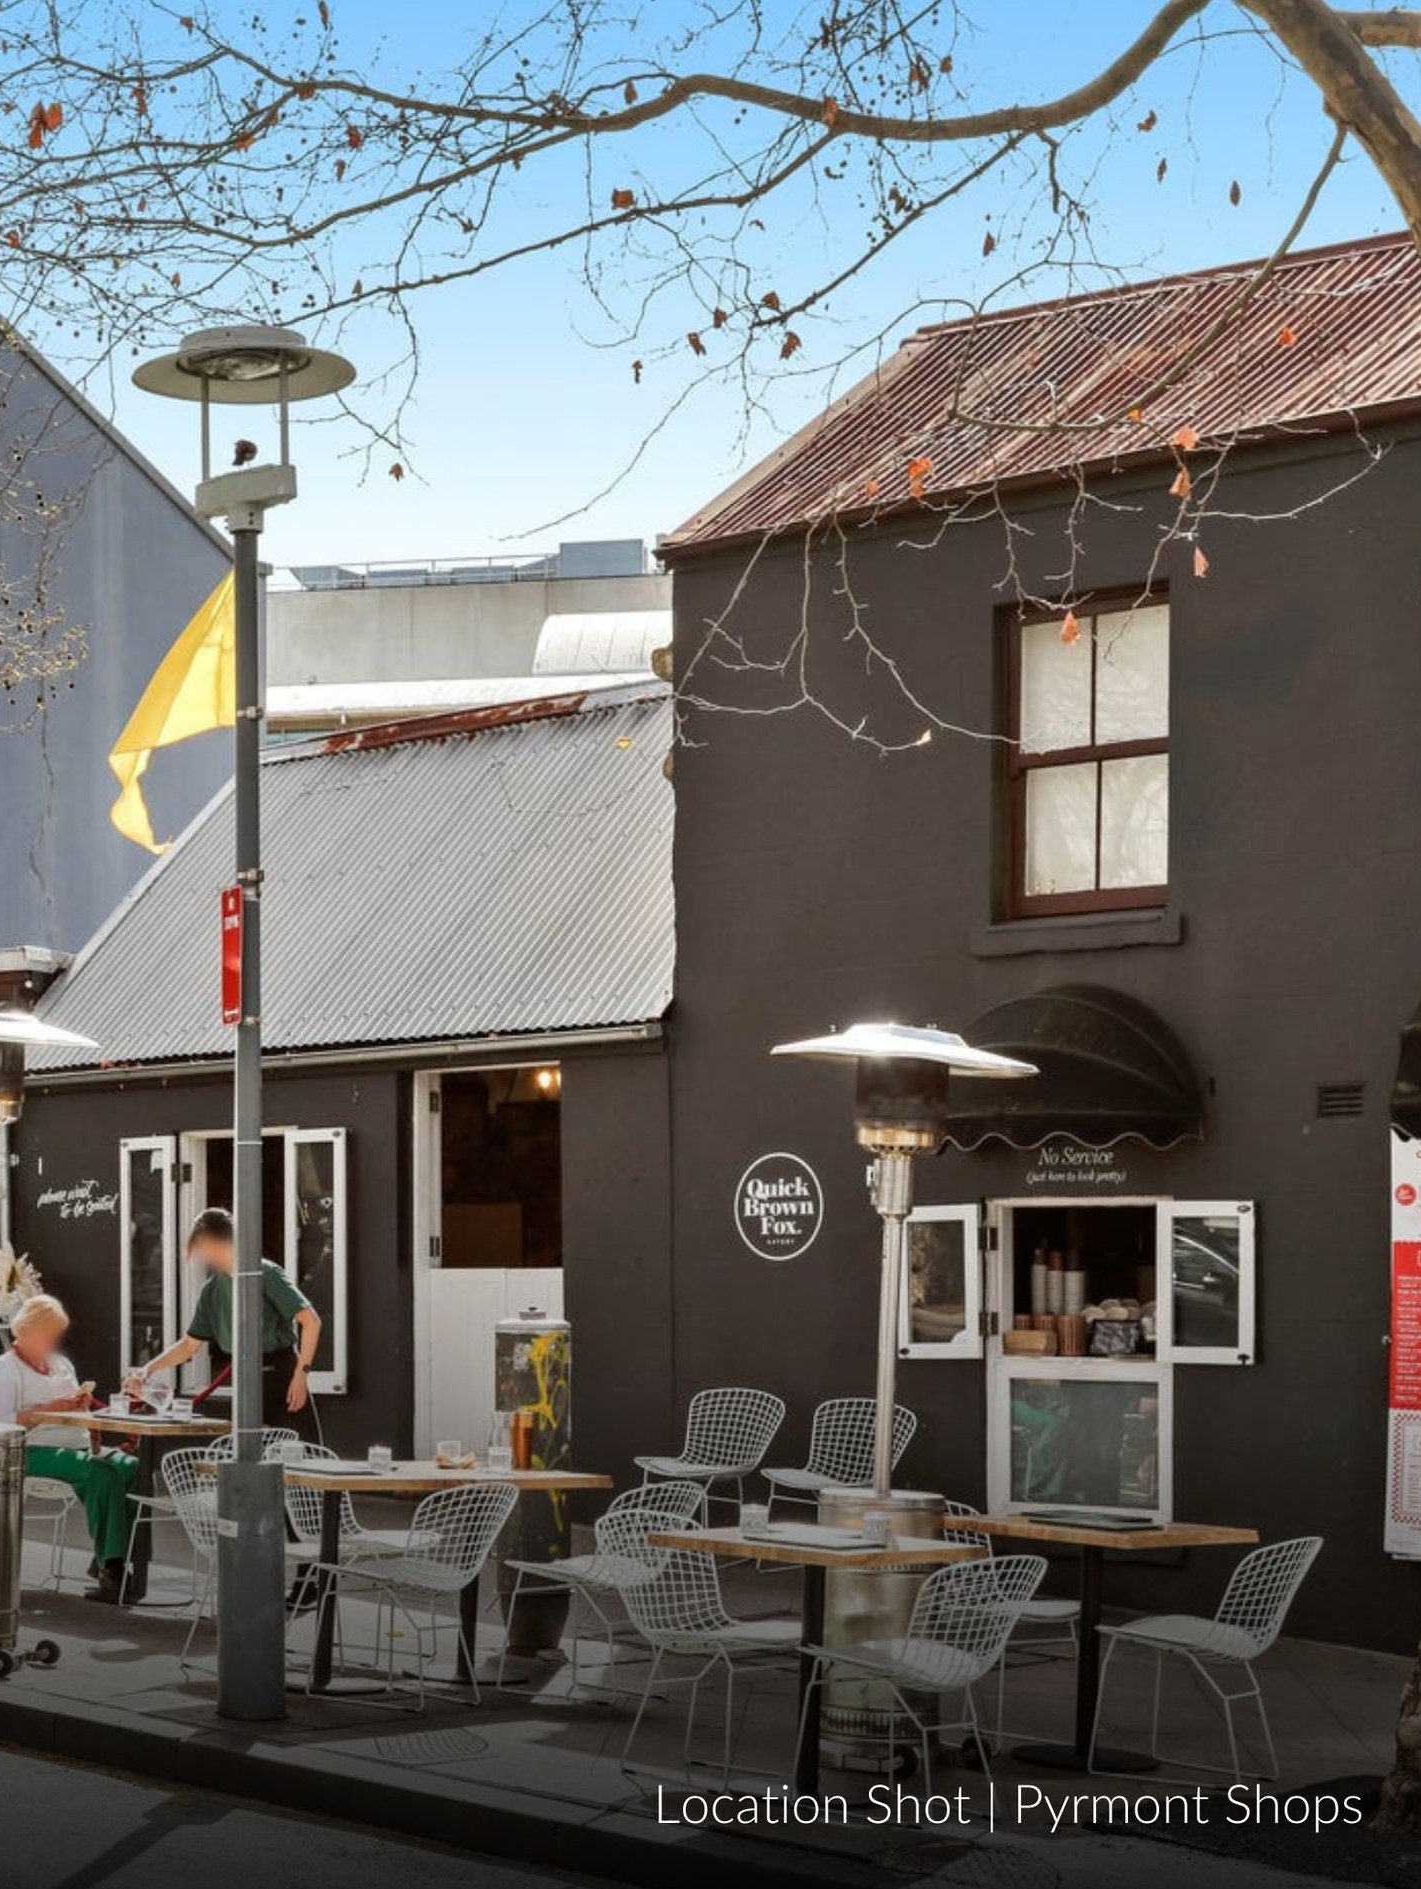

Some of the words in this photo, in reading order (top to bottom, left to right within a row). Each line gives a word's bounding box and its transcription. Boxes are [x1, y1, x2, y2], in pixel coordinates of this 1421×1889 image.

[1038, 1147, 1060, 1165] No
[1061, 1146, 1114, 1165] Service
[746, 1177, 810, 1201] Quick
[73, 1200, 85, 1218] be
[744, 1198, 815, 1216] Brown
[761, 1216, 802, 1235] Fox.
